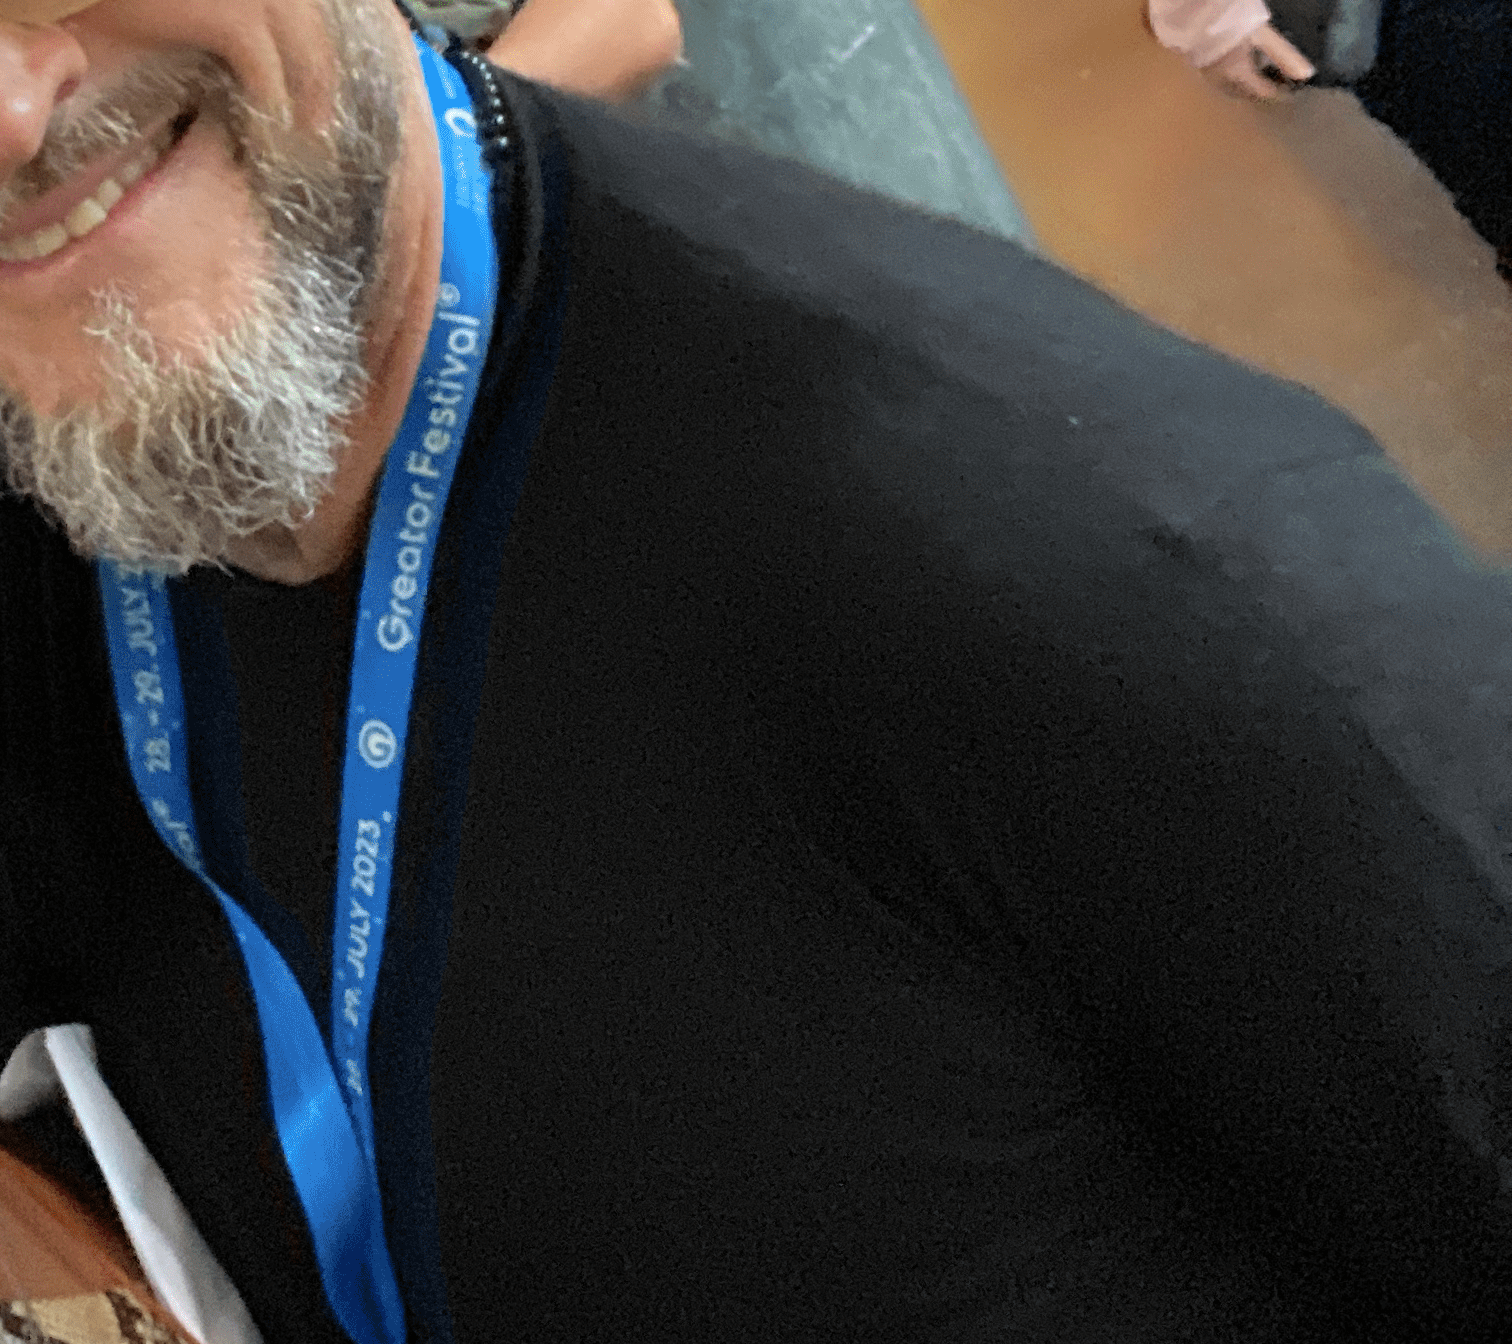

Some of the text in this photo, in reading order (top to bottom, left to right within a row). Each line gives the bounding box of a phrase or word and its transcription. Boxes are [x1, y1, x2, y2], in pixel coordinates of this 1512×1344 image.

[376, 480, 437, 652] Greator
[350, 818, 381, 897] 2023
[346, 899, 372, 979] JULY
